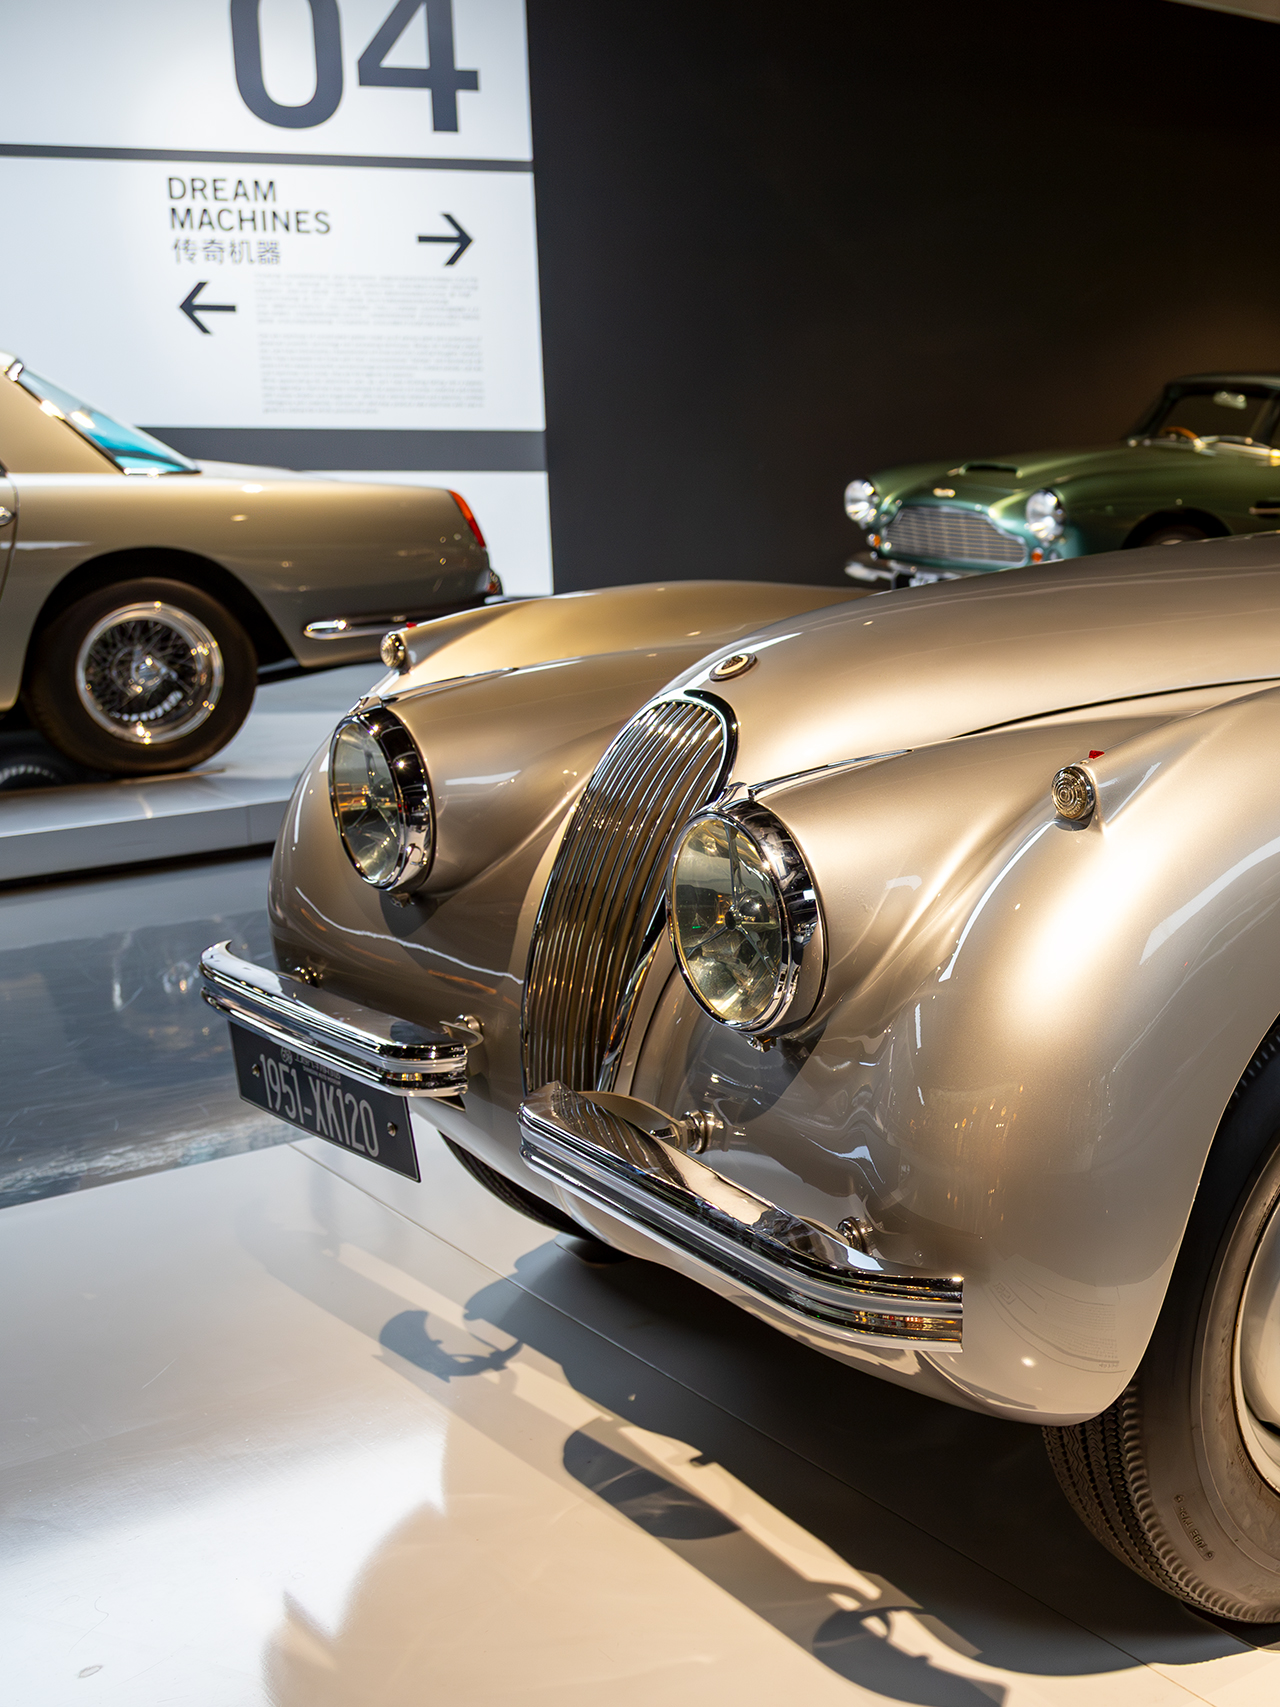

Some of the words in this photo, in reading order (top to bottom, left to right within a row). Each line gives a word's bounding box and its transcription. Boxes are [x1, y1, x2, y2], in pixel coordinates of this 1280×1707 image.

[230, 0, 479, 132] 04
[167, 177, 278, 203] DREAM
[169, 207, 331, 235] MACHINES
[172, 237, 281, 265] 传奇机器
[259, 1053, 380, 1158] 1951-XK120
